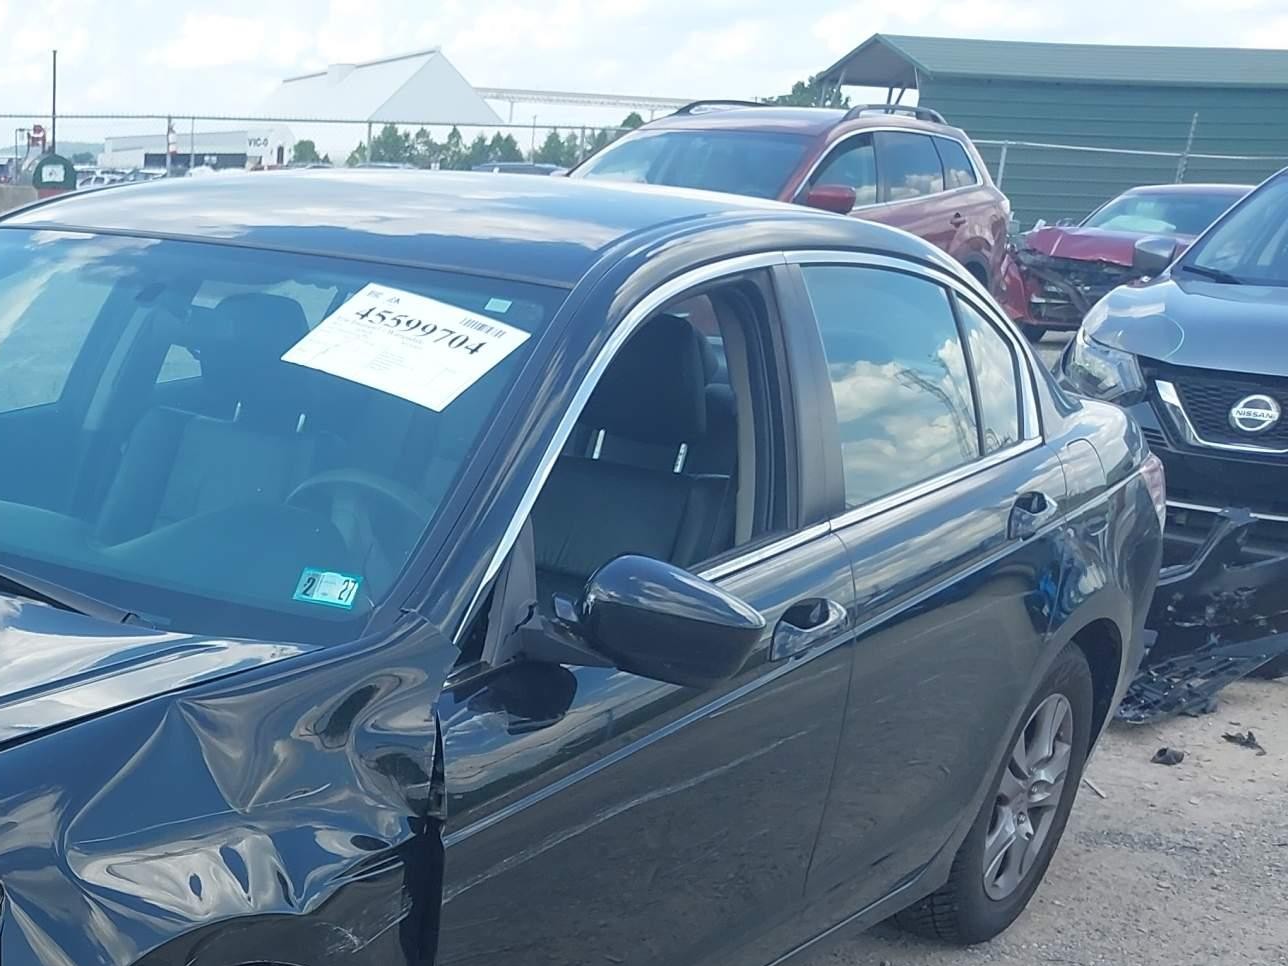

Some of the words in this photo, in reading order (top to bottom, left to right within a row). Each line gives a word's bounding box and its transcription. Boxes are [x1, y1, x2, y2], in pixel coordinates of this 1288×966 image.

[355, 306, 488, 355] 45599704
[1235, 409, 1273, 419] NISSAN
[302, 576, 316, 597] 2
